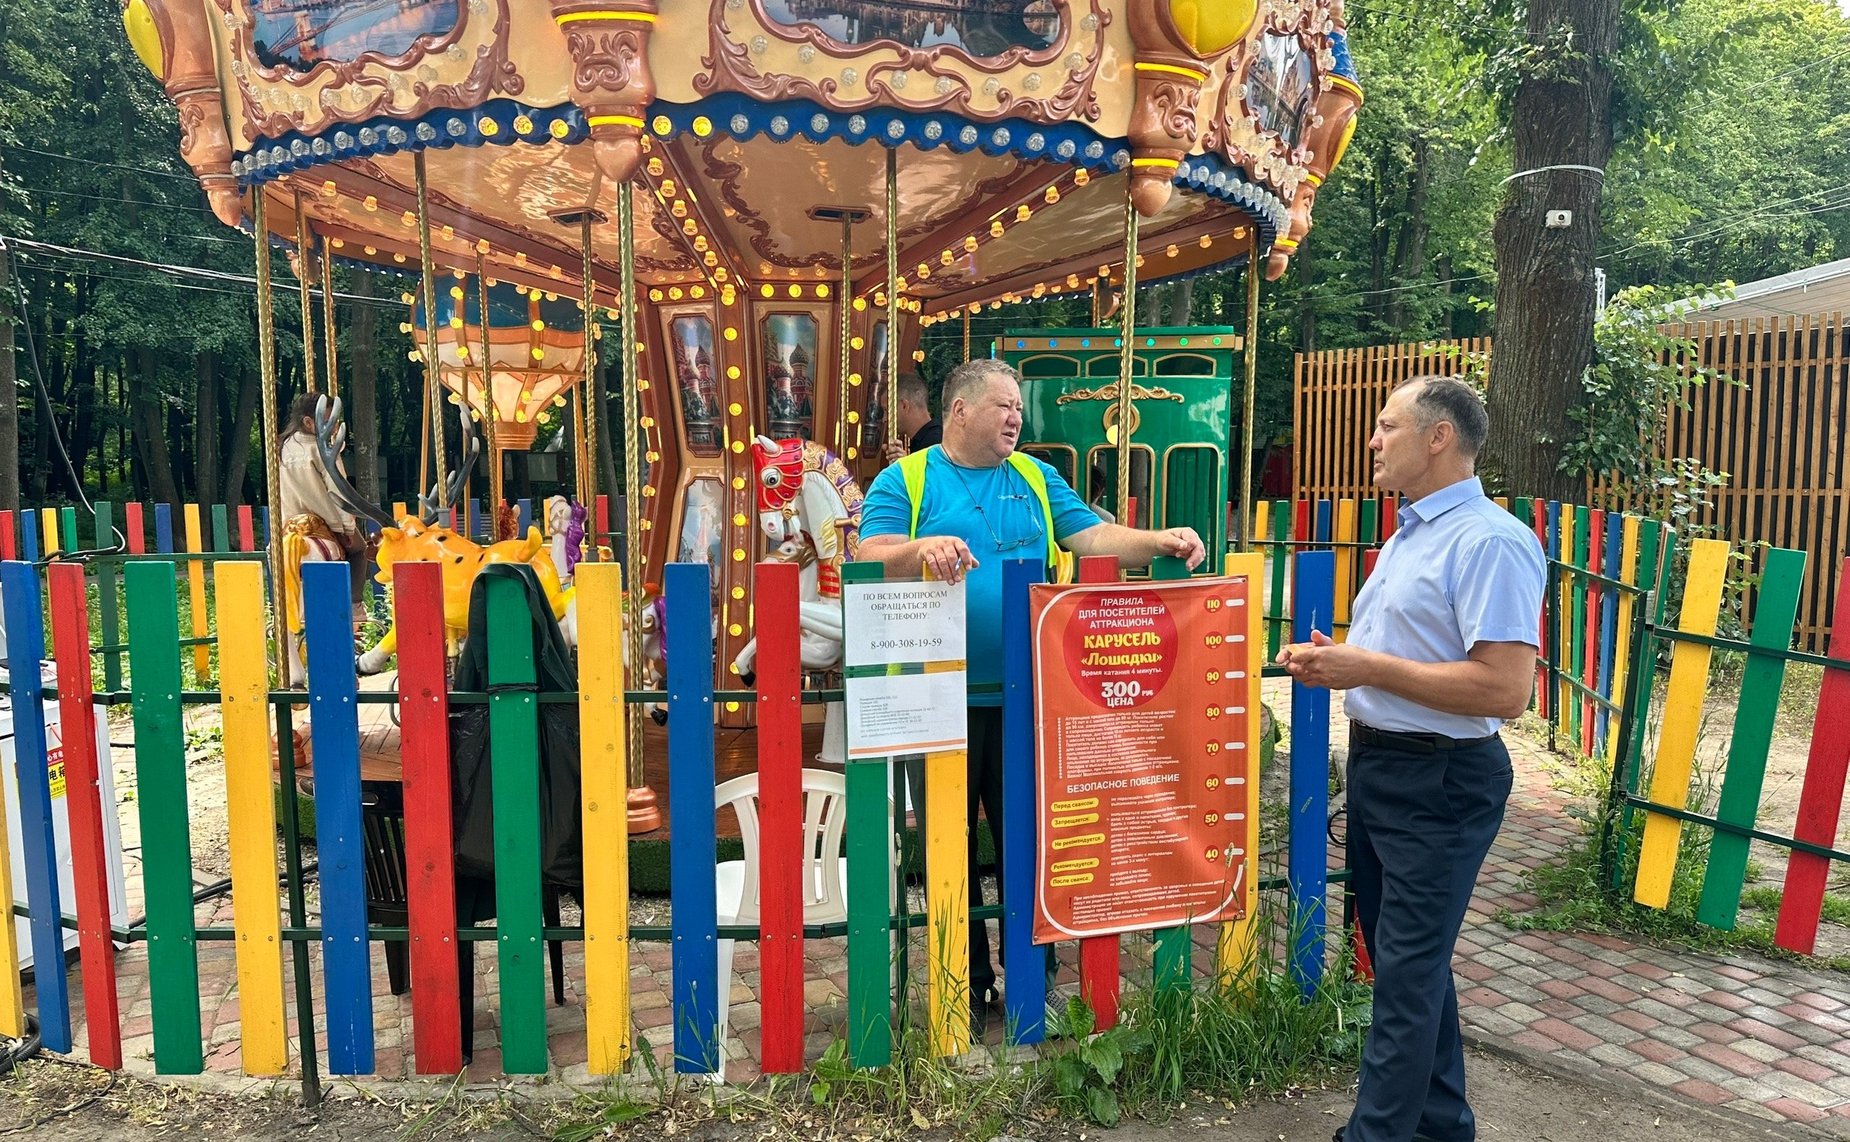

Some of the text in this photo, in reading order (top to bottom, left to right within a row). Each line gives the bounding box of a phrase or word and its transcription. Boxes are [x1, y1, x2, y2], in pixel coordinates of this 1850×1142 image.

[863, 590, 948, 601] ПО ВСЕМ ВОПРОСАМ
[870, 601, 941, 611] ОБРАЩАТЬСЯ ПО
[1100, 597, 1144, 606] ПРАВИЛА
[1206, 599, 1220, 609] 110
[883, 612, 928, 621] ТЕЛЕФОНУ
[1078, 605, 1165, 620] ДЛЯ ПОСЕТИТЕЛЕЙ
[1090, 618, 1154, 629] АТТРАКЦИОНА
[870, 638, 942, 649] 8-900-308-19-59
[1084, 631, 1161, 649] КАРУСЕЛЬ
[1205, 636, 1222, 646] 100
[1081, 652, 1163, 668] «Лошадки»
[1081, 670, 1102, 678] Время
[1206, 672, 1220, 682] 90
[1101, 680, 1141, 698] 300
[1107, 697, 1134, 708] ЦЕНА
[1206, 707, 1220, 717] 80
[1207, 744, 1219, 752] 70
[1067, 773, 1180, 794] БЕЗОПАСНОЕ ПОВЕДЕНИЕ
[1206, 778, 1219, 788] 60
[1205, 814, 1218, 823] 50
[1205, 849, 1218, 859] 40
